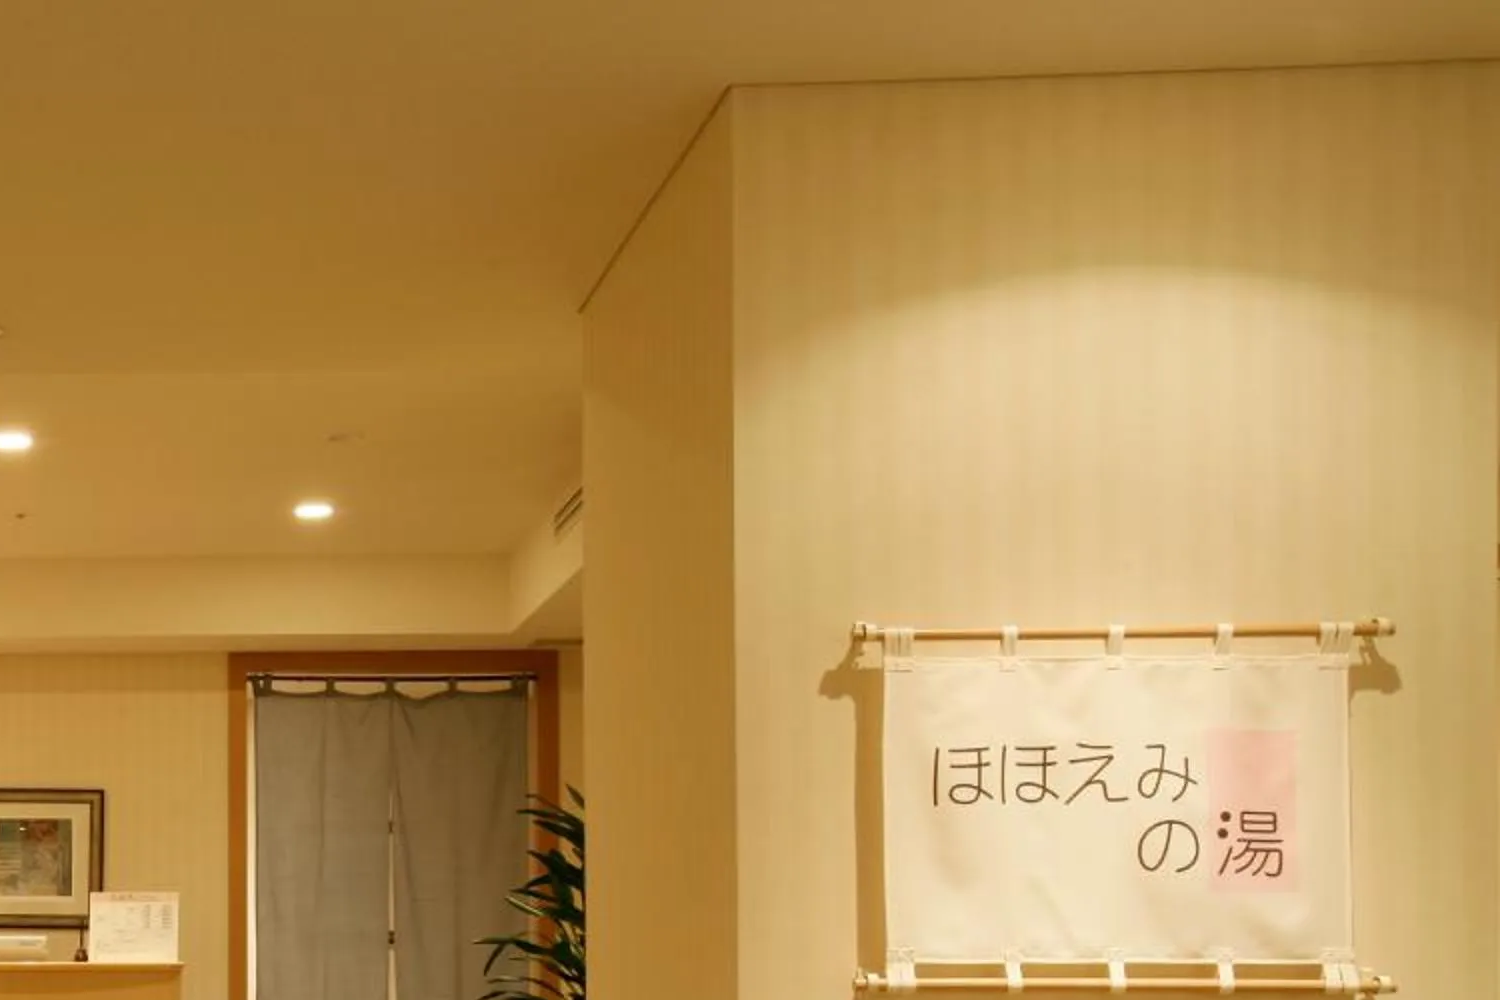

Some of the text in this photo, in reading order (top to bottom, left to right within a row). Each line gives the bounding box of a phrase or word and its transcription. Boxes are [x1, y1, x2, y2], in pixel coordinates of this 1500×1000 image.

[933, 742, 1198, 807] ほほえみ
[1137, 810, 1285, 878] の湯
